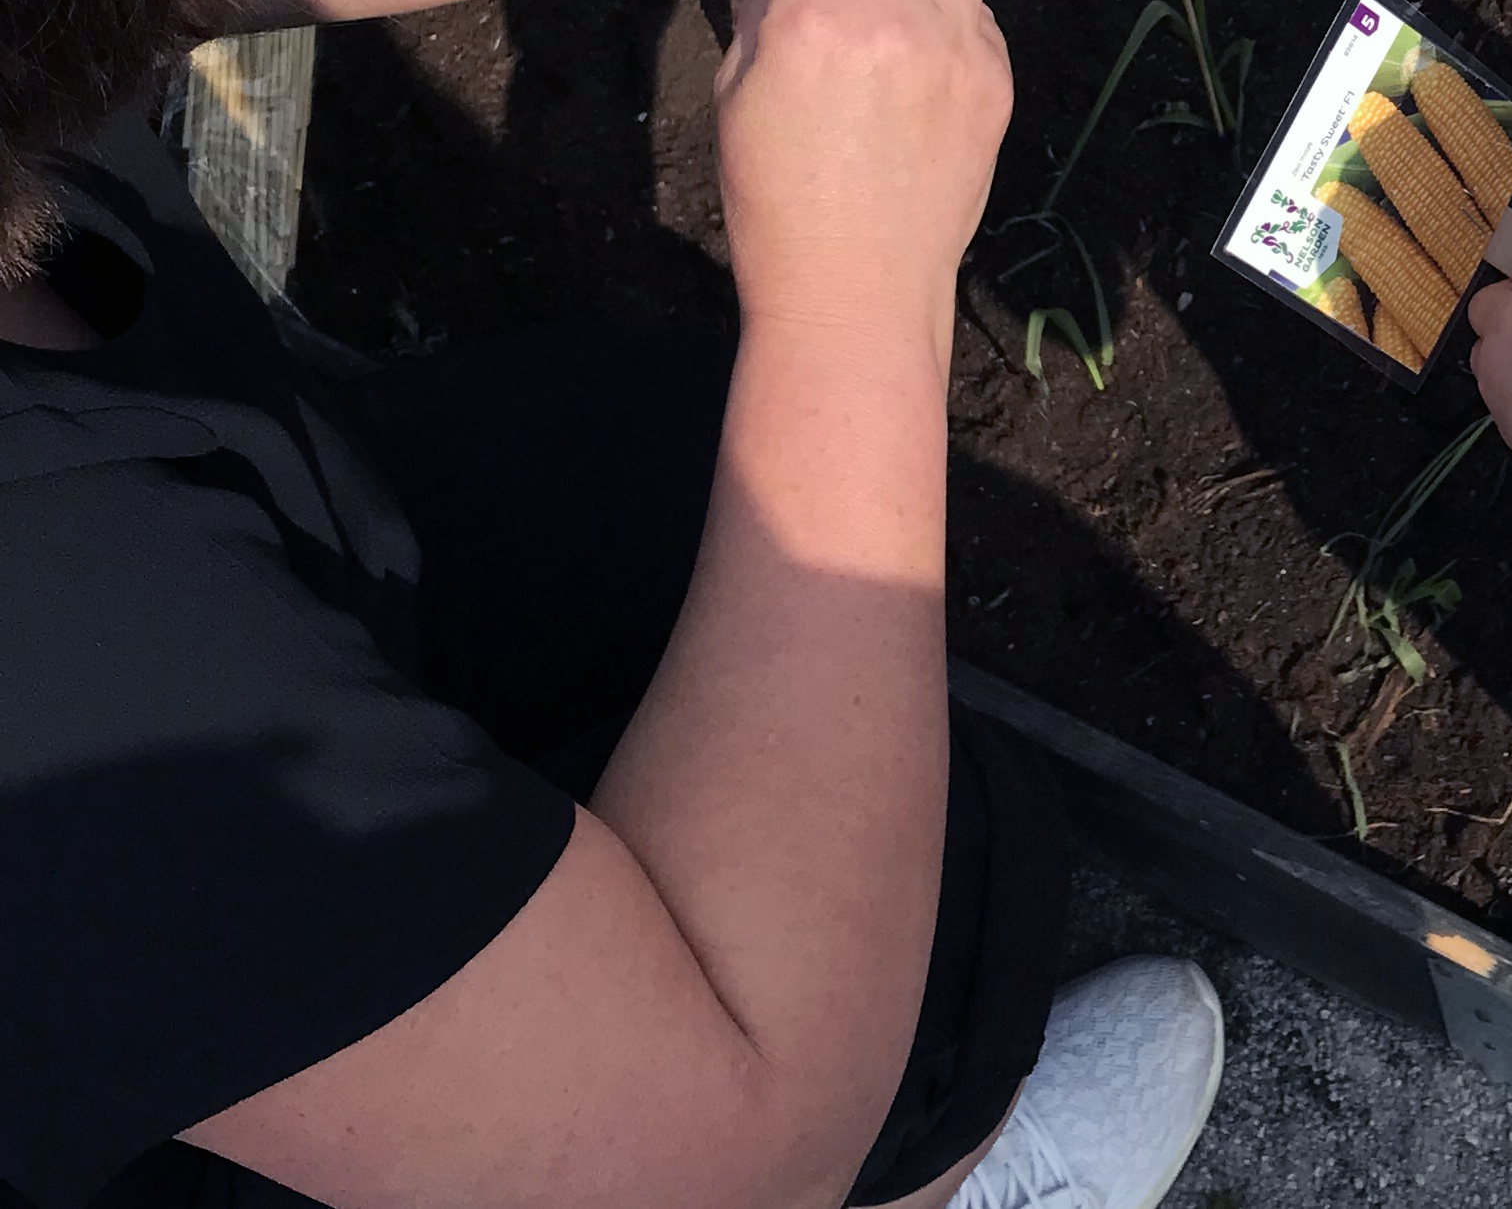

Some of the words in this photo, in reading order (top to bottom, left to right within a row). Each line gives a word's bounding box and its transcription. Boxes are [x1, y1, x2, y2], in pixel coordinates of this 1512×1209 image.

[1361, 15, 1375, 31] 5
[1343, 90, 1356, 105] F1
[1293, 217, 1324, 268] NELSON
[1302, 222, 1333, 272] GARDEN
